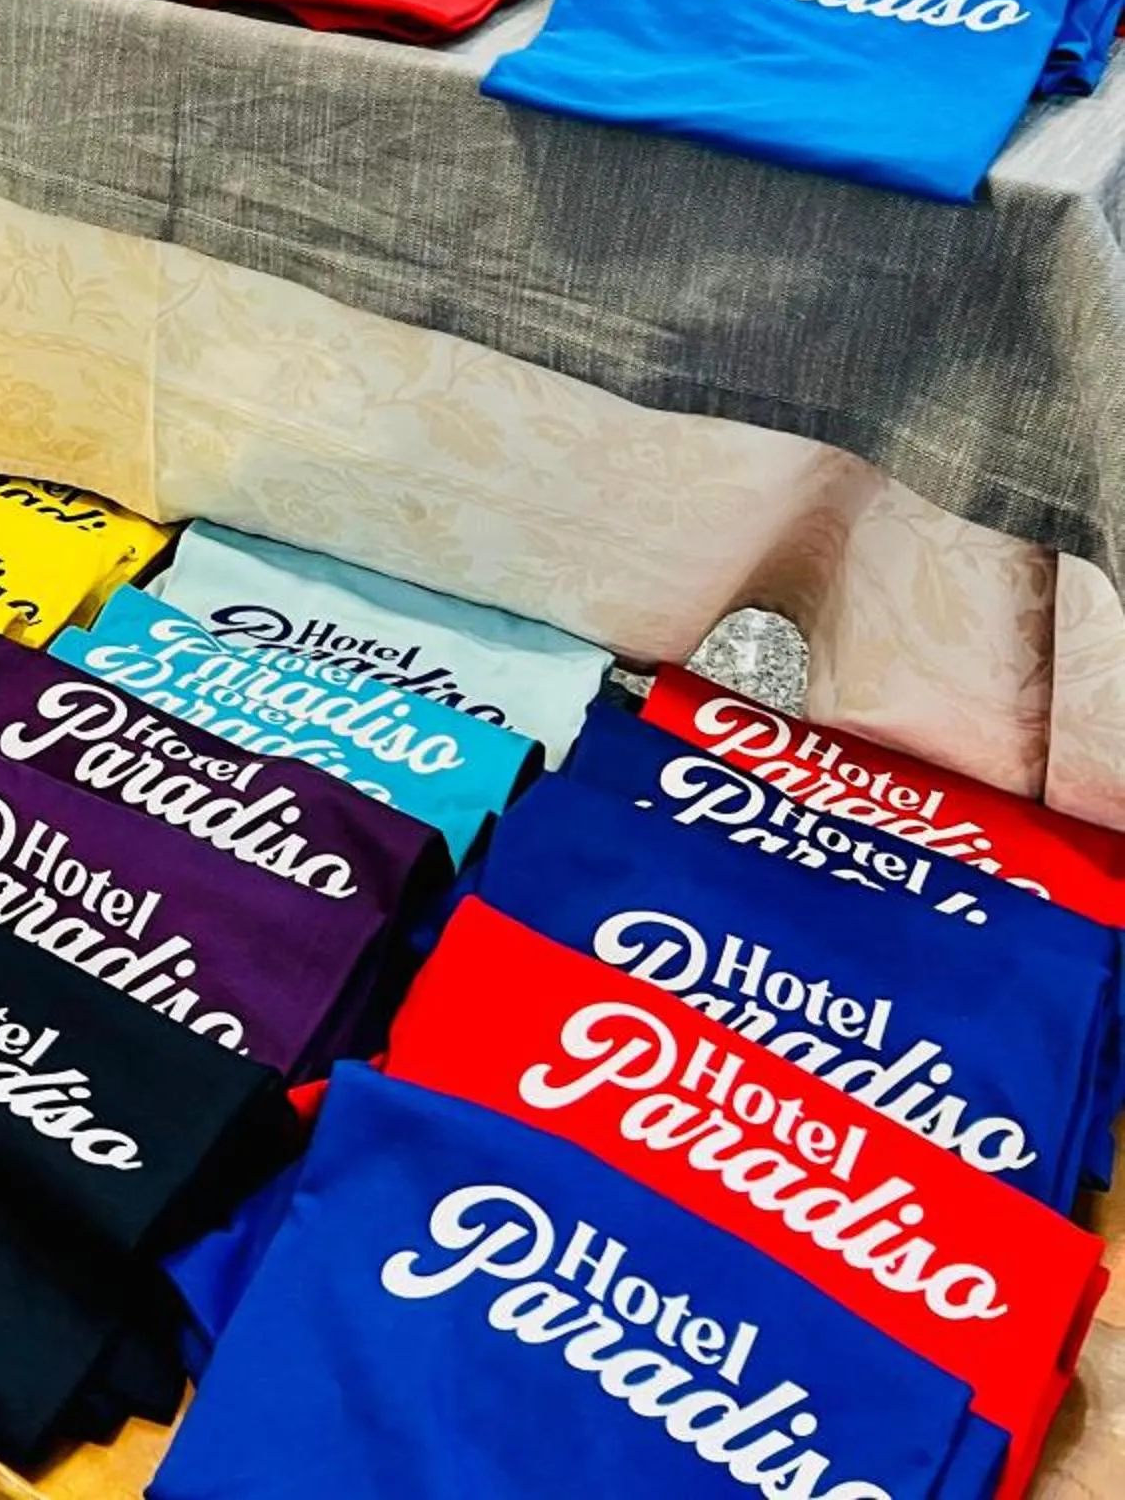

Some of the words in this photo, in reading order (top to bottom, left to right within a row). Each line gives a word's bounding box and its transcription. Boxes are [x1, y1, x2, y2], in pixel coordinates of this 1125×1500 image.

[296, 620, 422, 672] Hotel
[0, 681, 358, 899] Paradiso
[122, 714, 263, 793] Hotel
[795, 732, 945, 820] Hotel
[12, 821, 165, 941] Hotel
[768, 798, 932, 895] Hotel
[713, 934, 892, 1050] Hotel
[518, 1001, 1009, 1322] Paradiso
[679, 1037, 868, 1182] Hotel
[554, 1220, 759, 1386] Hotel
